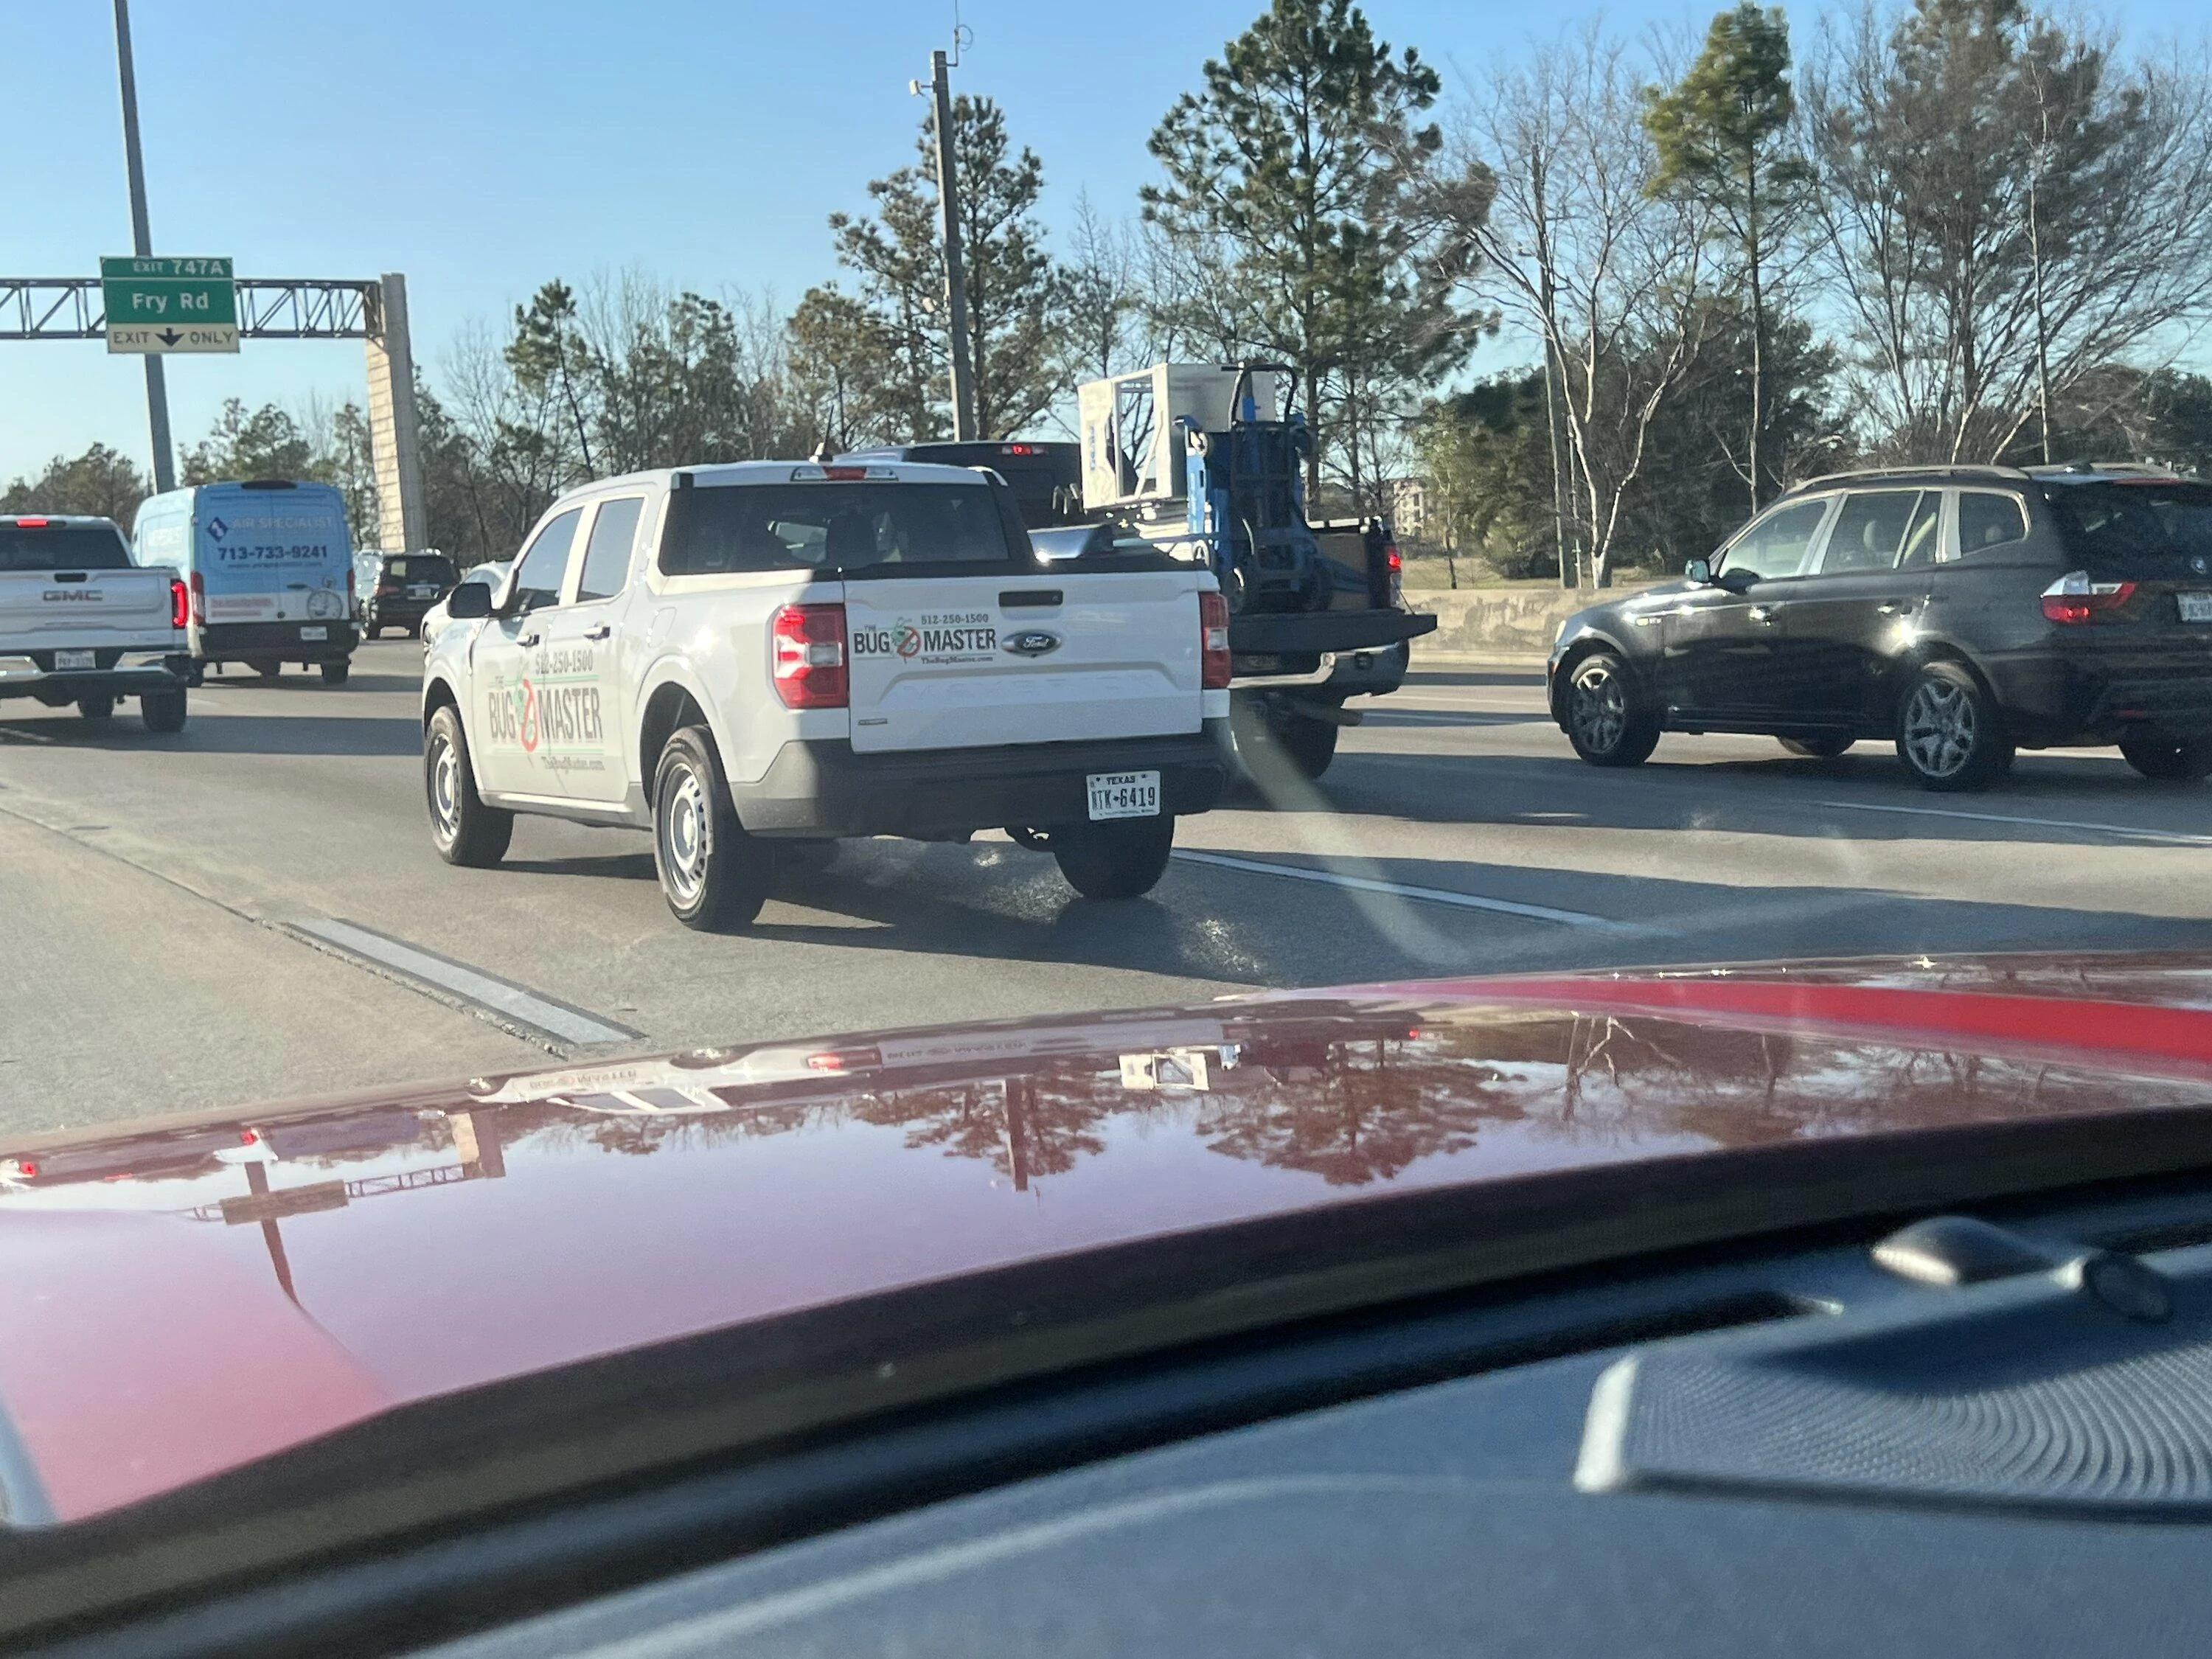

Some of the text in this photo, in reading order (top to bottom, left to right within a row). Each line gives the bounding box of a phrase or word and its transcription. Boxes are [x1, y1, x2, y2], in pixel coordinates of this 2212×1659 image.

[132, 260, 224, 275] EXIT 747A
[132, 292, 209, 314] Fry Rd
[114, 330, 234, 344] EXIT ONLY
[218, 544, 327, 560] 713-733-9241
[43, 589, 103, 601] GMC
[921, 613, 990, 625] 512-250-1500
[853, 627, 995, 654] BUG MASTER
[1023, 636, 1050, 648] Ford
[488, 686, 603, 740] BUG MASTER
[1106, 776, 1135, 785] TEXAS
